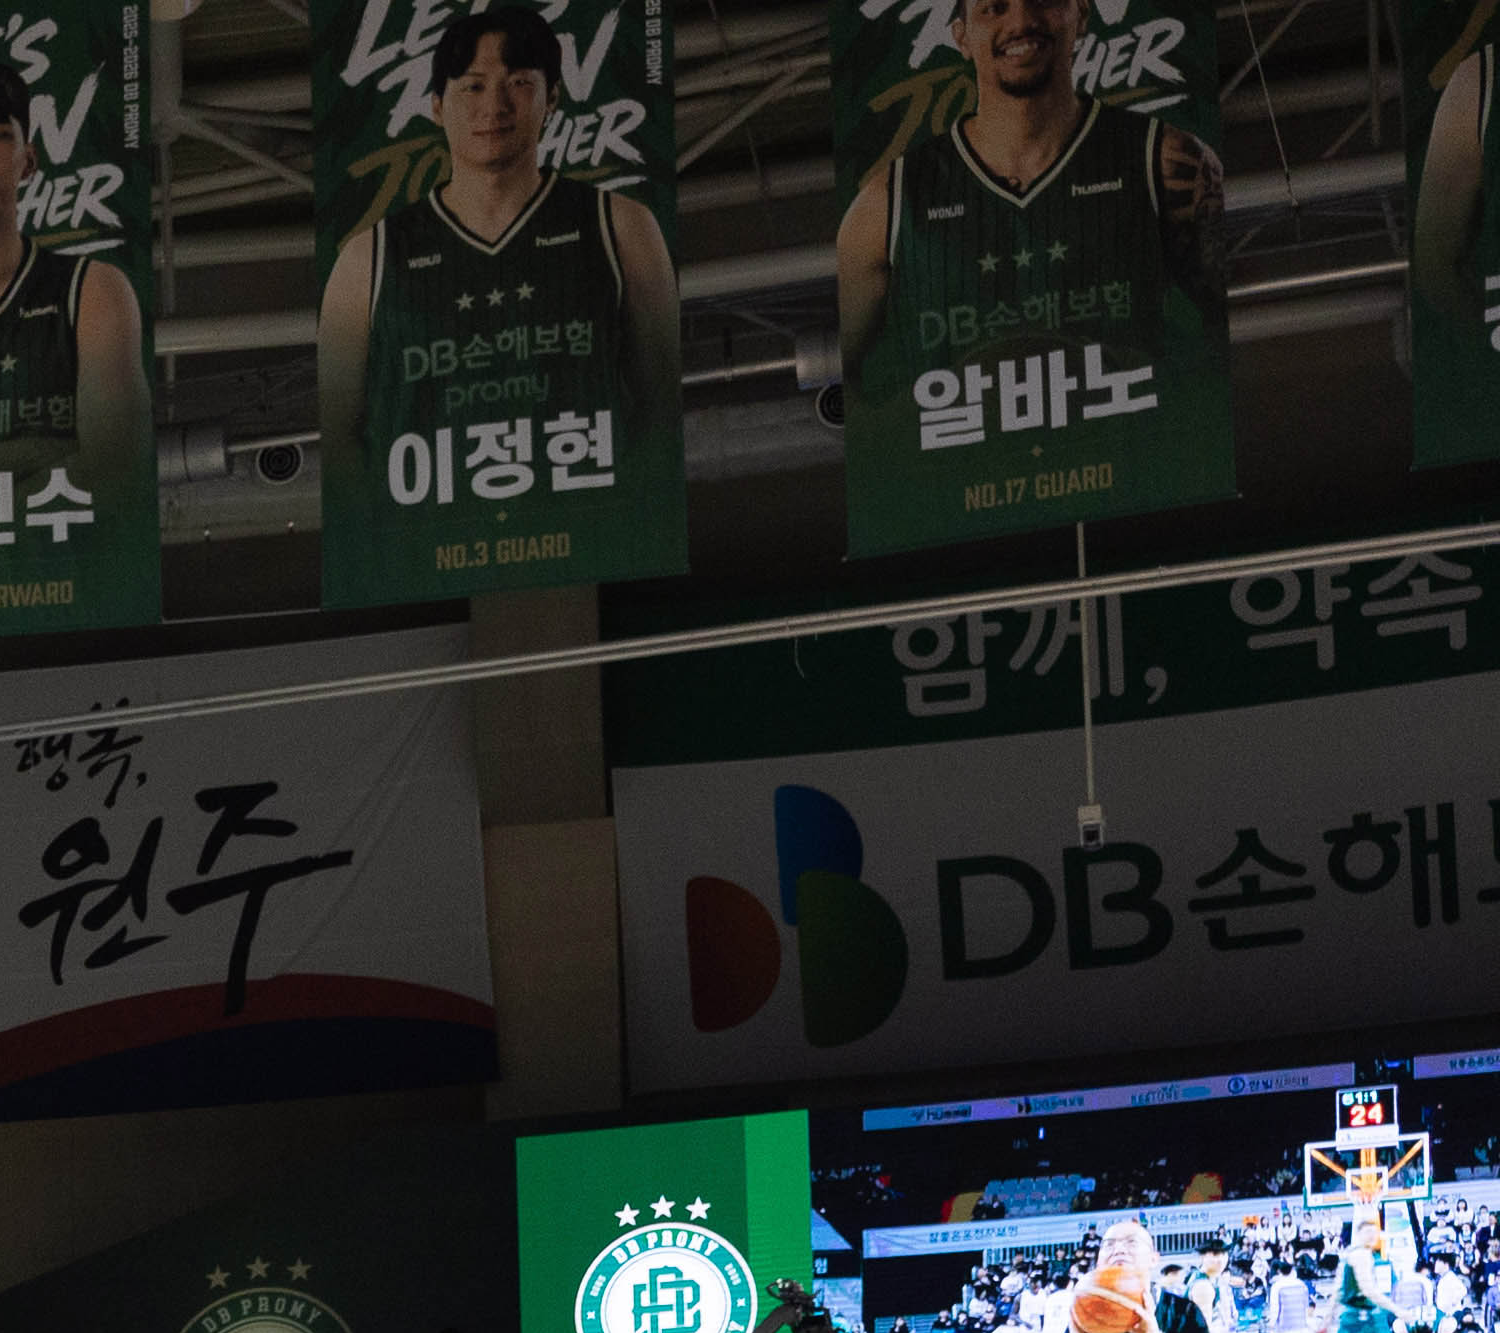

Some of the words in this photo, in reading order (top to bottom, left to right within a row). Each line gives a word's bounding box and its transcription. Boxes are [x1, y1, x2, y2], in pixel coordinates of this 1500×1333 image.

[401, 318, 596, 384] DB손해보험
[912, 342, 1159, 452] 알바노
[386, 409, 618, 510] 이정현
[964, 475, 1026, 512] NO.17
[1034, 462, 1114, 501] GUARD
[435, 543, 489, 573] NO.3
[495, 531, 572, 565] GUARD
[17, 781, 355, 1017] 원주
[936, 799, 1500, 984] DB손해
